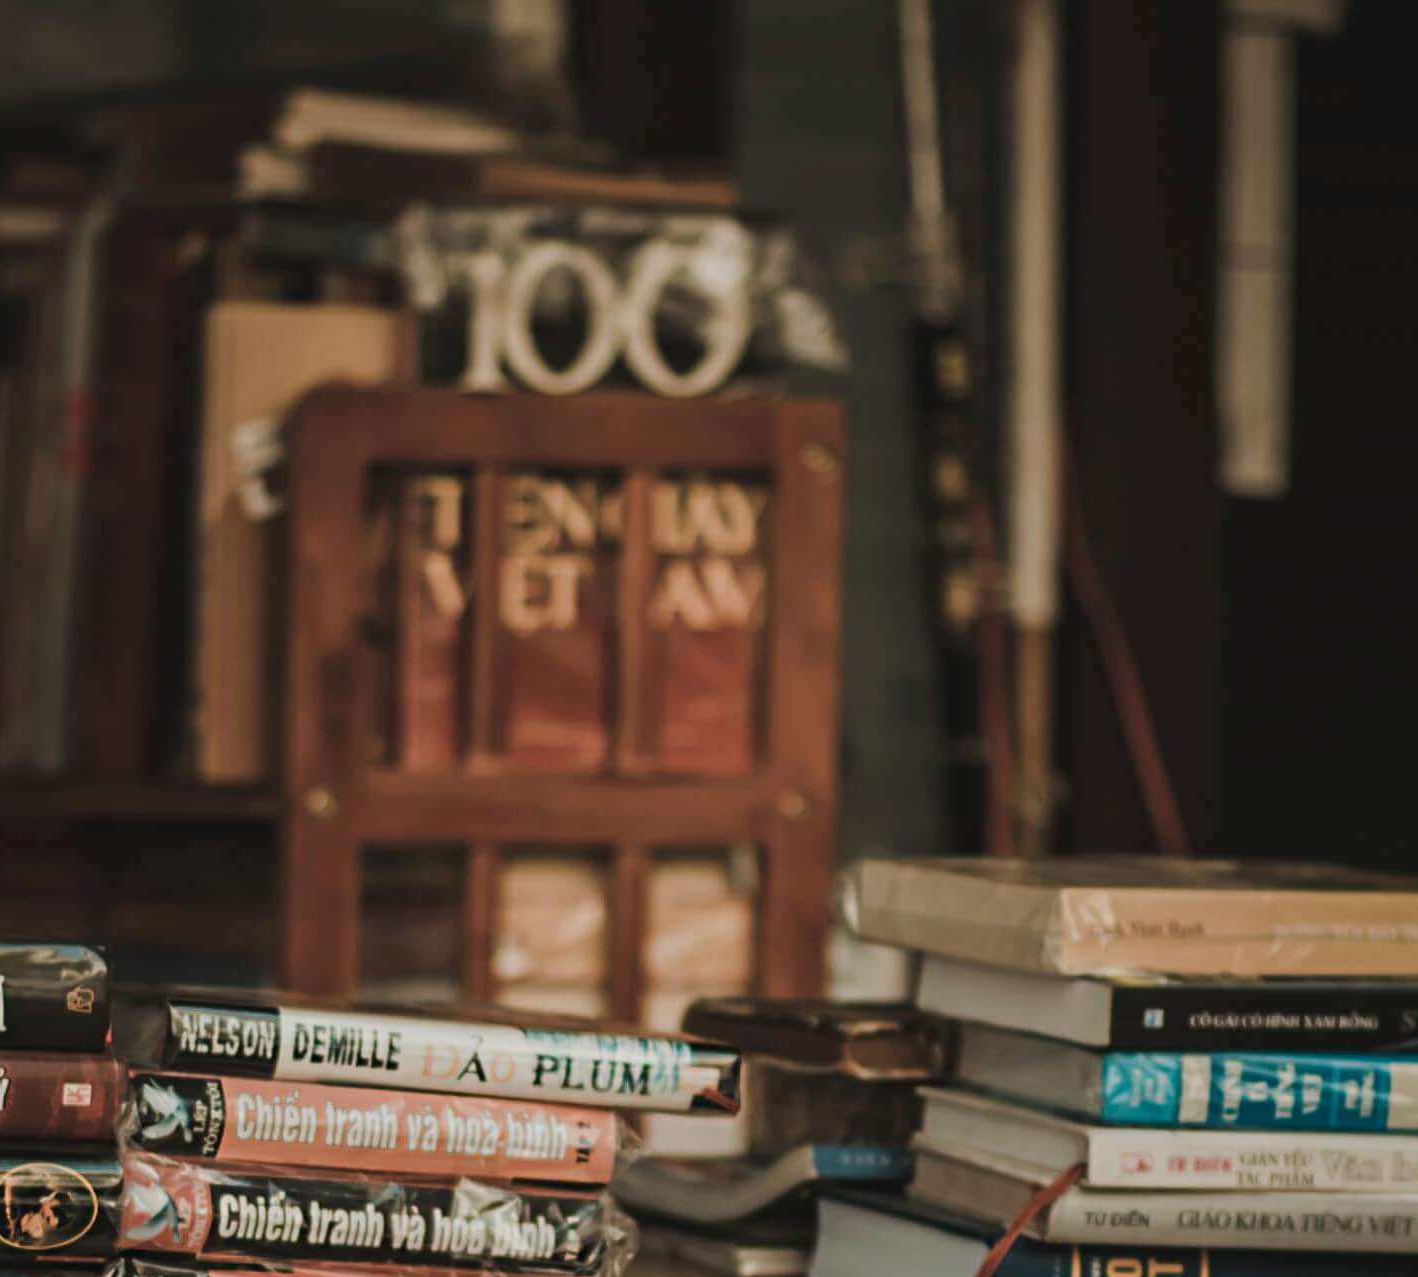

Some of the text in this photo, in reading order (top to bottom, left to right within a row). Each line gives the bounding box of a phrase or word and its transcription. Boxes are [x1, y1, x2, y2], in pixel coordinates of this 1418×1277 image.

[179, 1010, 655, 1098] NELSON DEMILLE PLUM
[324, 1100, 398, 1150] tranh
[406, 1104, 439, 1152] và
[504, 1111, 568, 1161] bình
[307, 1198, 426, 1252] tranh và
